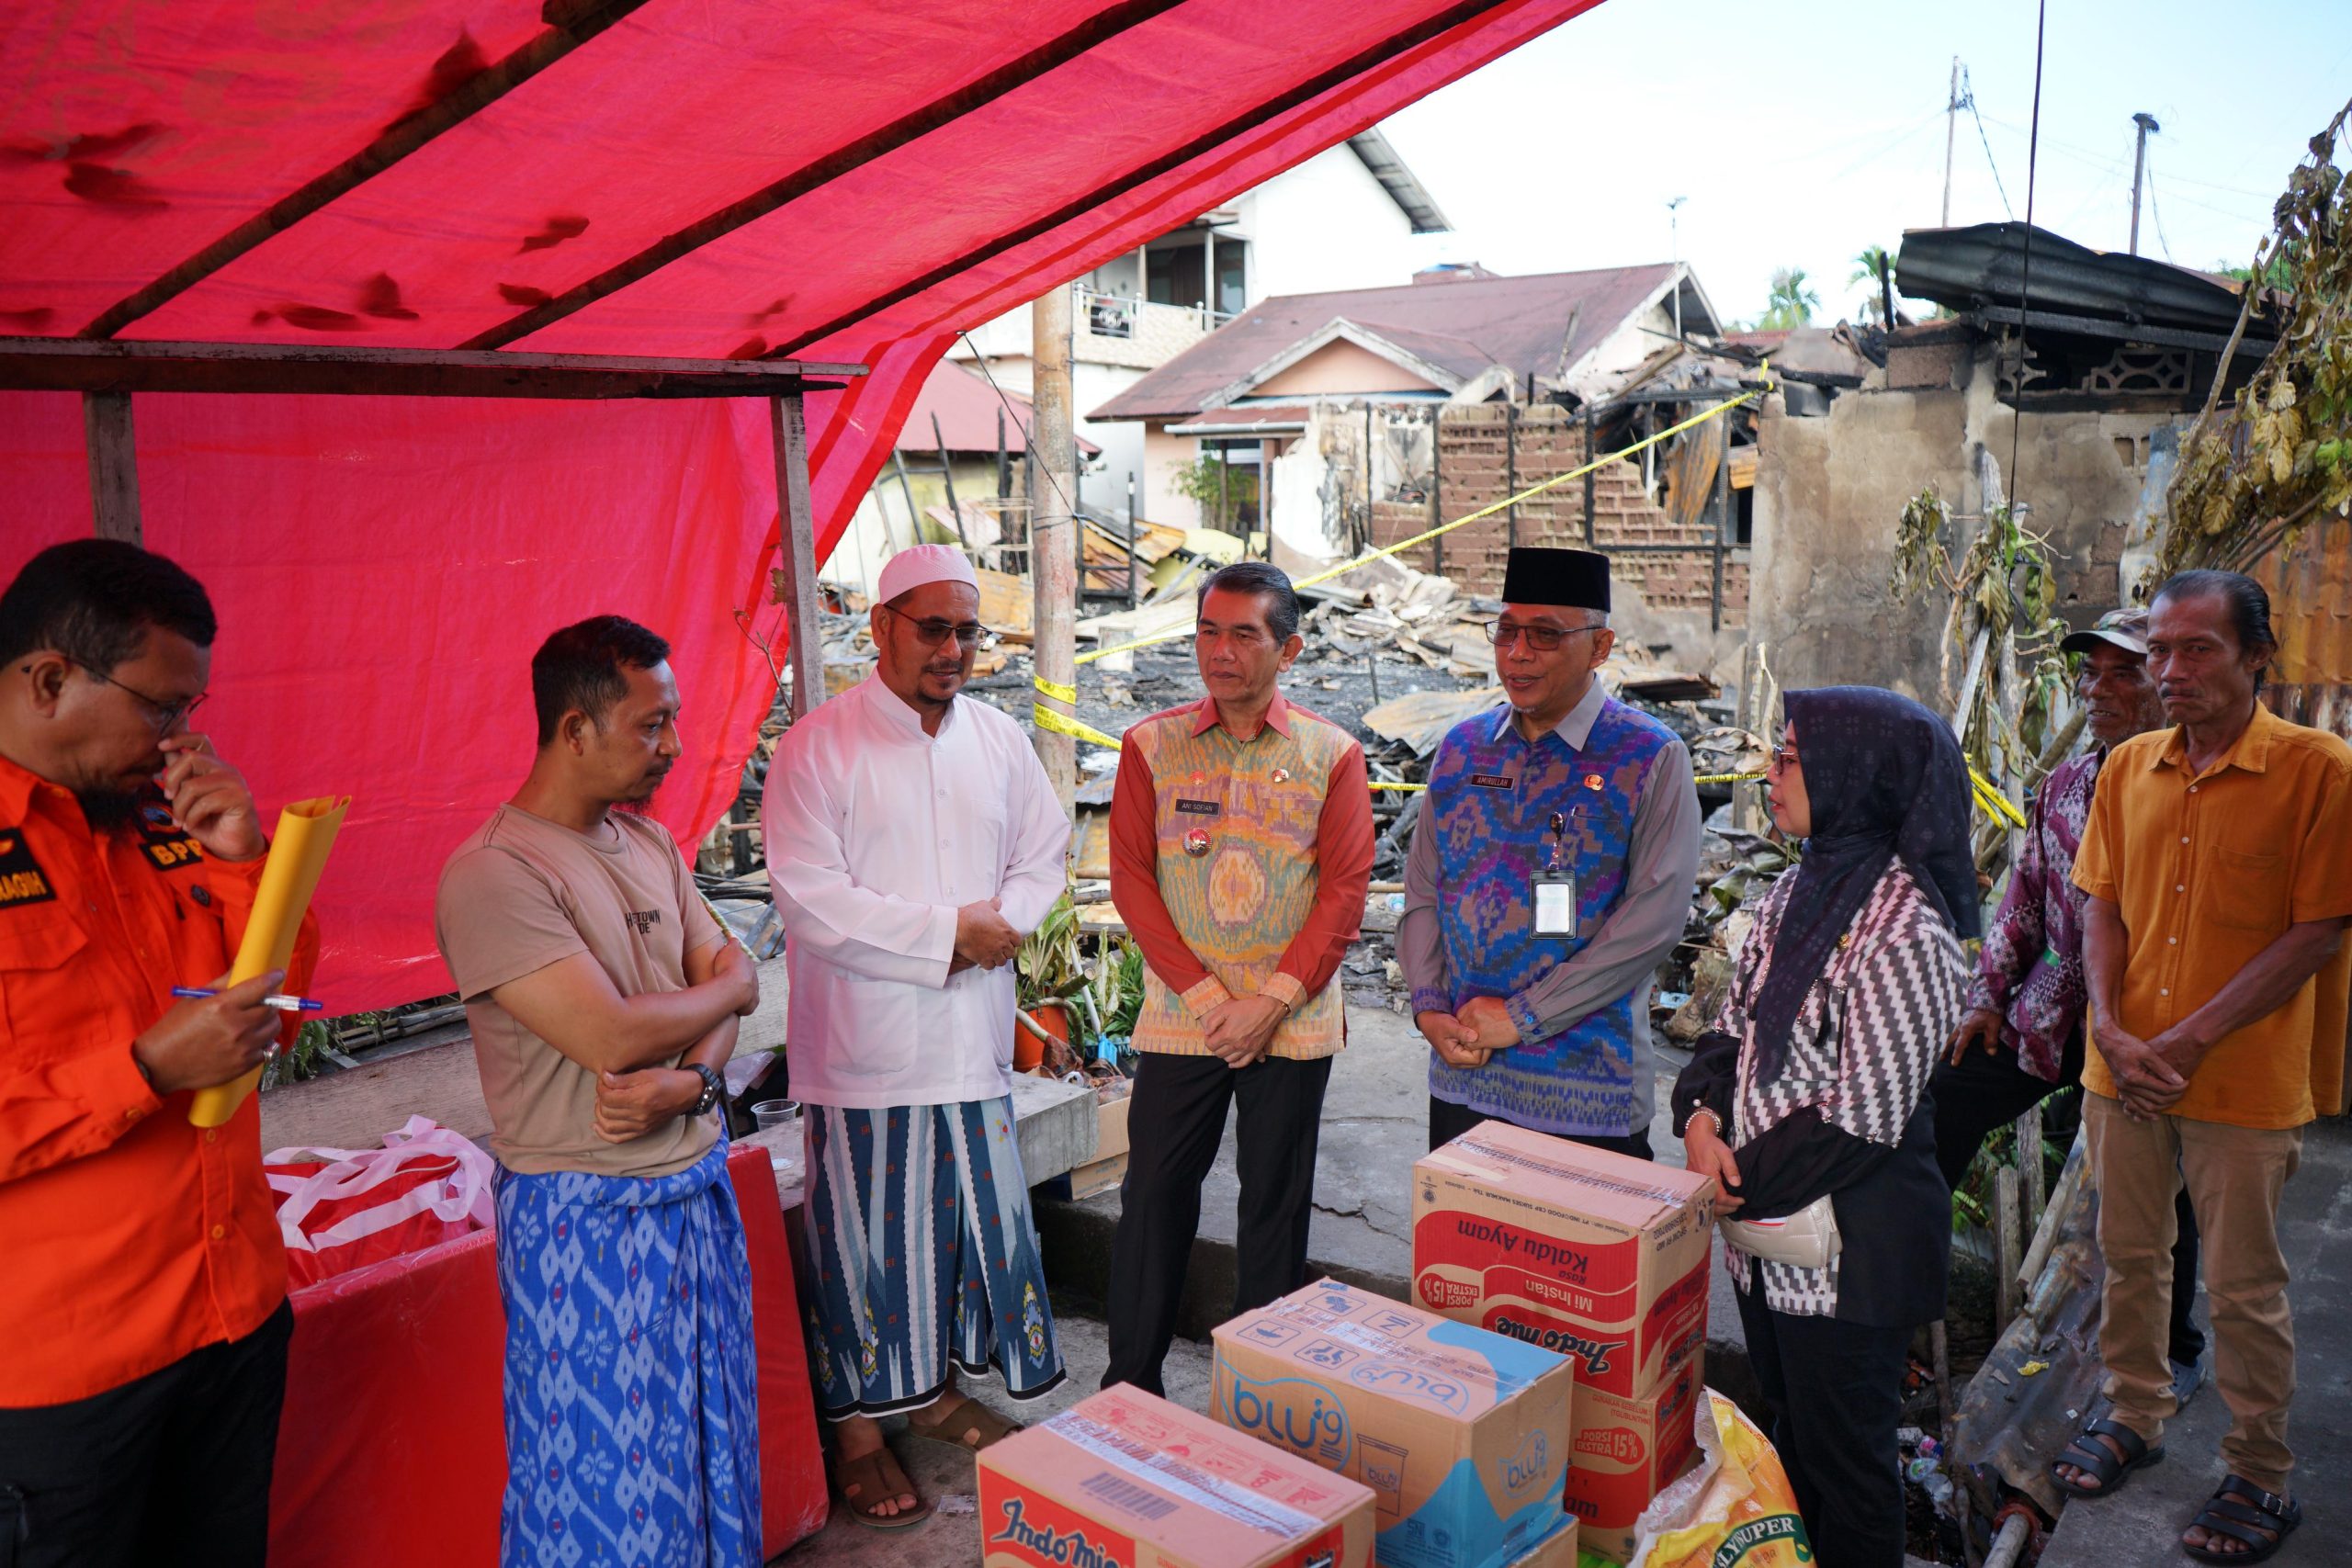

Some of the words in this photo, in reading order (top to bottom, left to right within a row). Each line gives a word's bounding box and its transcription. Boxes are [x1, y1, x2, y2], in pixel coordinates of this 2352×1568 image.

[1476, 776, 1509, 787] AMIRULLAH
[1485, 1192, 1511, 1203] MAKMUR
[1512, 1199, 1533, 1210] SUKSES
[1546, 1209, 1580, 1222] INDOFOOD
[1457, 1219, 1519, 1251] Ayam
[1523, 1238, 1589, 1274] Kaldu
[1557, 1270, 1588, 1285] Rasa
[1423, 1278, 1445, 1304] 15%
[1446, 1281, 1478, 1296] EKSTRA
[1524, 1280, 1572, 1307] Instan
[1446, 1294, 1472, 1306] PORSI
[1575, 1296, 1593, 1313] Mi
[1583, 1431, 1611, 1442] PORSI
[1577, 1440, 1611, 1456] EKSTRA
[1613, 1433, 1638, 1460] 15%
